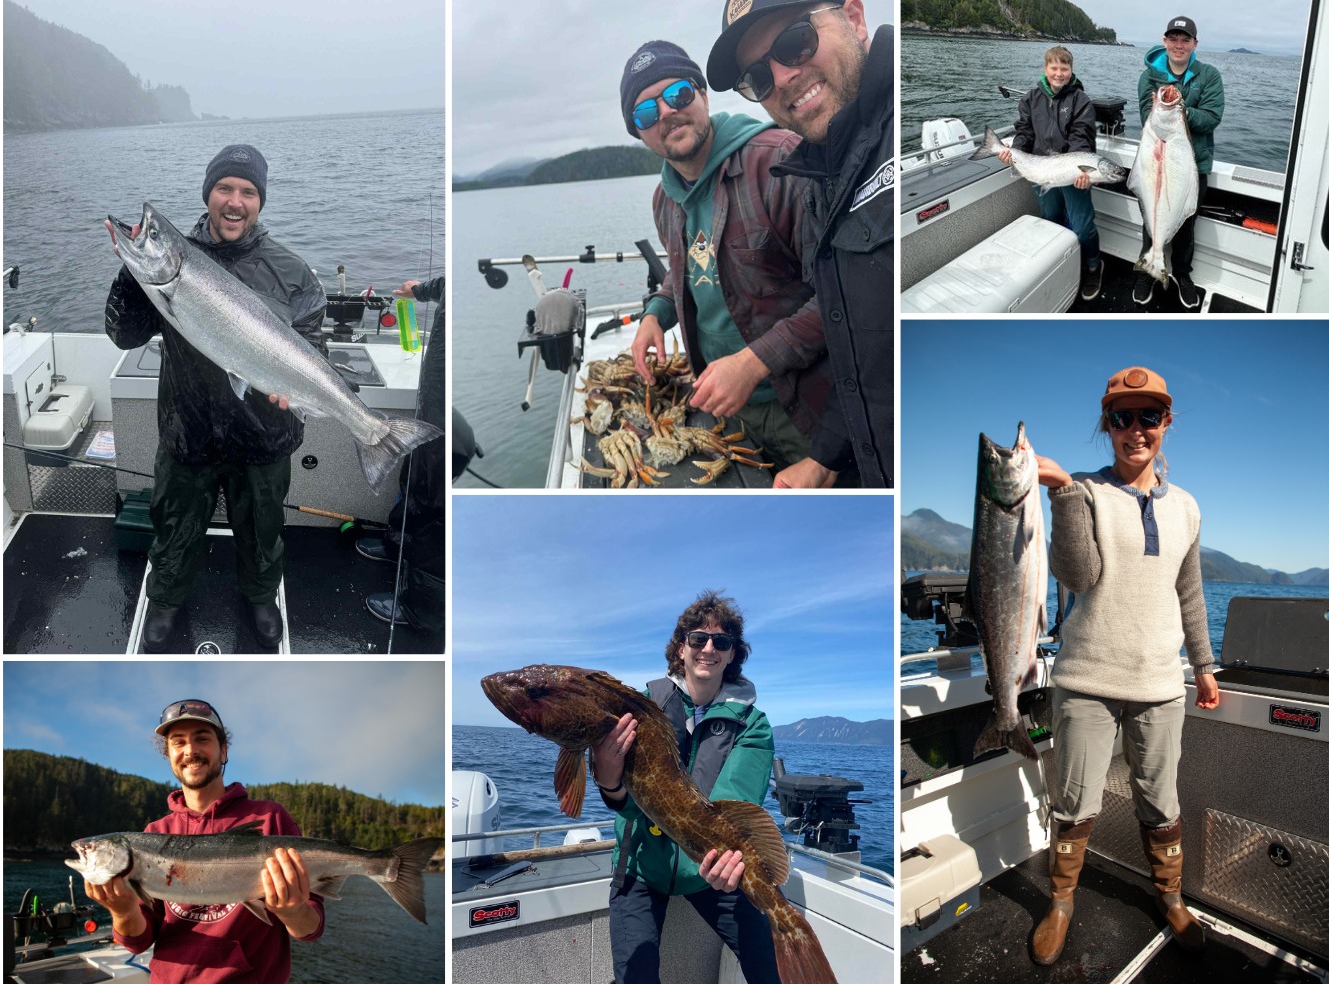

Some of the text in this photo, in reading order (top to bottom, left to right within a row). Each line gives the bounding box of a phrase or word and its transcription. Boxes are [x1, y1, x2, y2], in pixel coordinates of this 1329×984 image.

[1273, 709, 1316, 726] Scotty
[189, 910, 226, 921] FESTIVAL
[473, 905, 517, 921] Scotty
